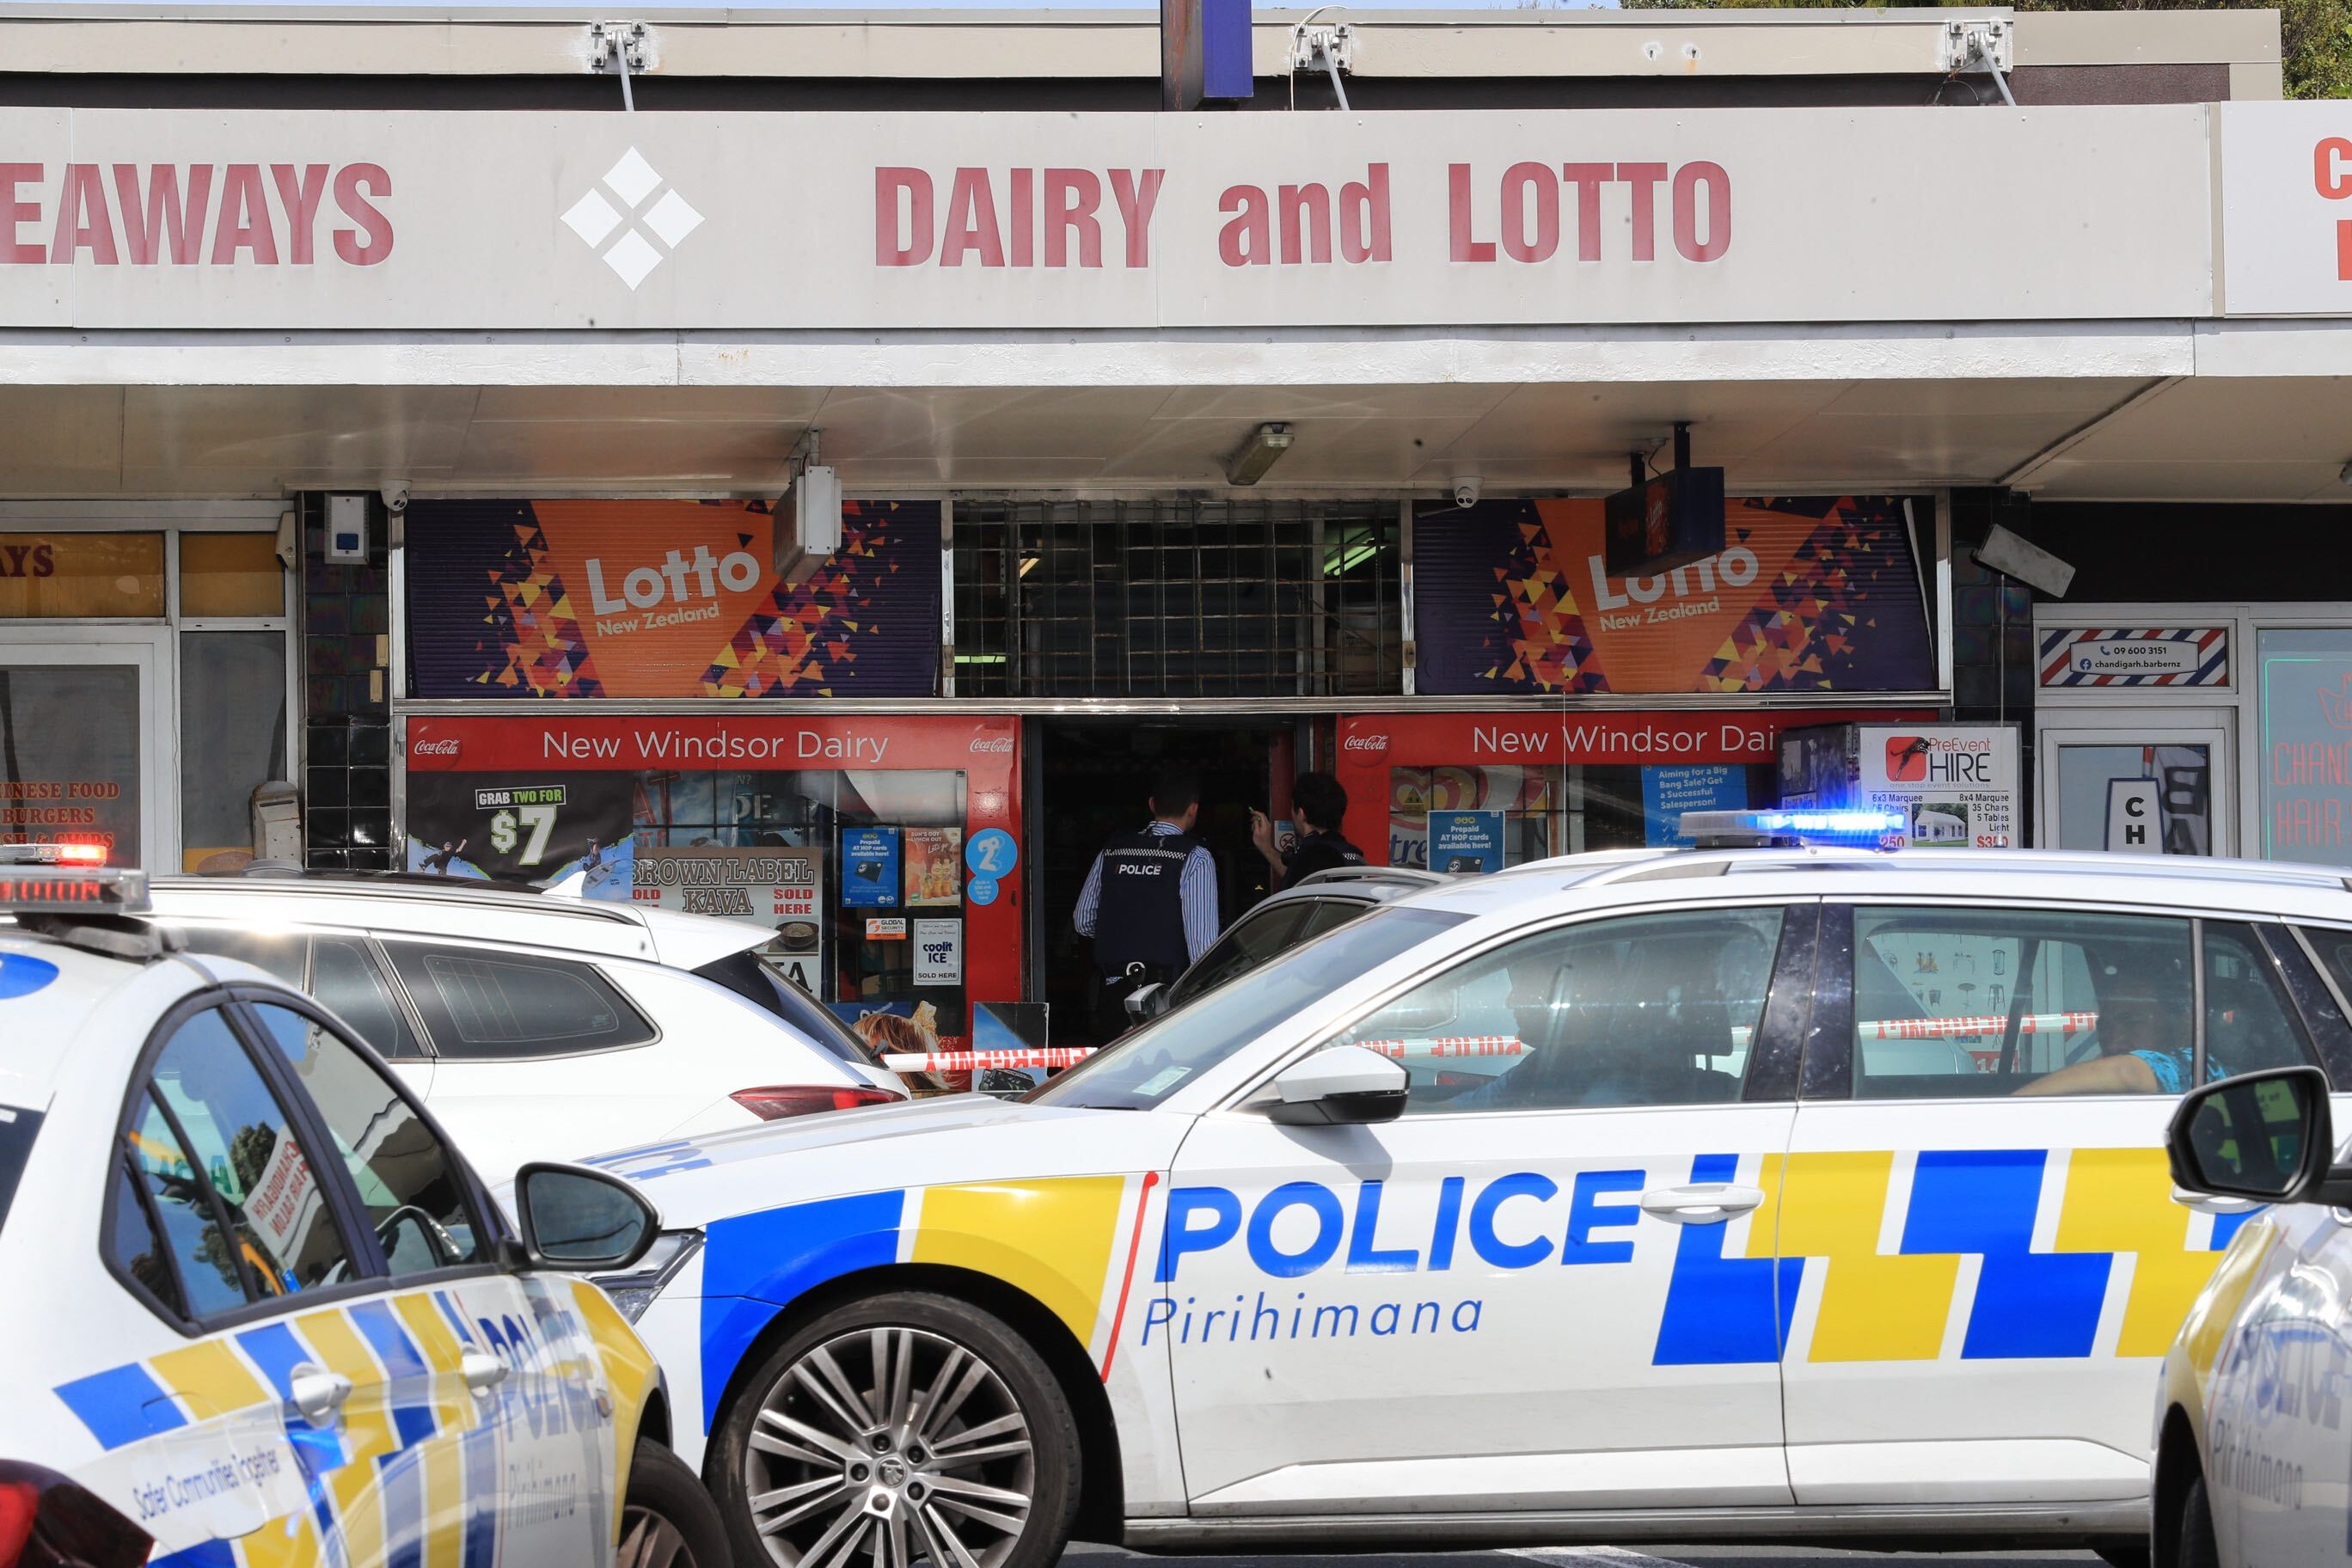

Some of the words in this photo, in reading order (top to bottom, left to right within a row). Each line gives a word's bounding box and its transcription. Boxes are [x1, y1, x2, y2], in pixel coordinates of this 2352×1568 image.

[0, 162, 394, 266] EAWAYS
[875, 166, 1166, 268] DAIRY
[1218, 162, 1392, 268] and
[1449, 160, 1732, 263] LOTTO
[585, 545, 760, 616] Lotto
[597, 619, 639, 637] New
[645, 604, 720, 629] Zealand
[1599, 611, 1641, 633] New
[1646, 597, 1720, 624] Zealand
[2113, 646, 2128, 655] 09
[2130, 646, 2147, 655] 600
[2148, 646, 2167, 655] 3151
[2095, 659, 2181, 670] chandigarh.barbernz
[414, 738, 460, 755] Coca-Cola
[543, 731, 621, 758] New
[634, 730, 784, 758] Windsor
[798, 731, 889, 763] Dairy
[970, 737, 1014, 753] Coca-Cola
[1344, 734, 1389, 751] Coca-Cola
[1473, 726, 1549, 753] New
[1563, 725, 1708, 753] Windsor
[1930, 738, 1991, 751] PreEvent
[1713, 766, 1728, 775] Big
[1930, 752, 1991, 782] HIRE
[0, 782, 61, 799] INESE
[68, 782, 119, 799] FOOD
[1684, 778, 1706, 787] Sale?
[479, 792, 510, 805] GRAB
[512, 790, 536, 804] TWO
[539, 789, 562, 802] FOR
[1668, 787, 1713, 799] Successful
[1872, 793, 1887, 802] 6x3
[1889, 793, 1923, 803] Marquee
[1959, 793, 1974, 802] 8x4
[1975, 793, 2009, 803] Marquee
[1661, 798, 1716, 809] Salesperson!
[3, 808, 95, 824] BURGERS
[1977, 813, 1982, 822] 5
[2275, 799, 2342, 847] HAIR
[491, 805, 557, 866] $7
[1879, 836, 1905, 848] 250
[633, 858, 721, 885] BROWN
[726, 858, 814, 885] LABEL
[1118, 864, 1161, 875] POLICE
[683, 887, 754, 916] KAVA
[775, 889, 812, 899] SOLD
[775, 903, 812, 915] HERE
[923, 941, 952, 952] coolit
[928, 953, 946, 963] ICE
[1154, 1169, 1646, 1284] POLICE
[1142, 1291, 1483, 1346] Pirihimana
[132, 1481, 168, 1521] Safer
